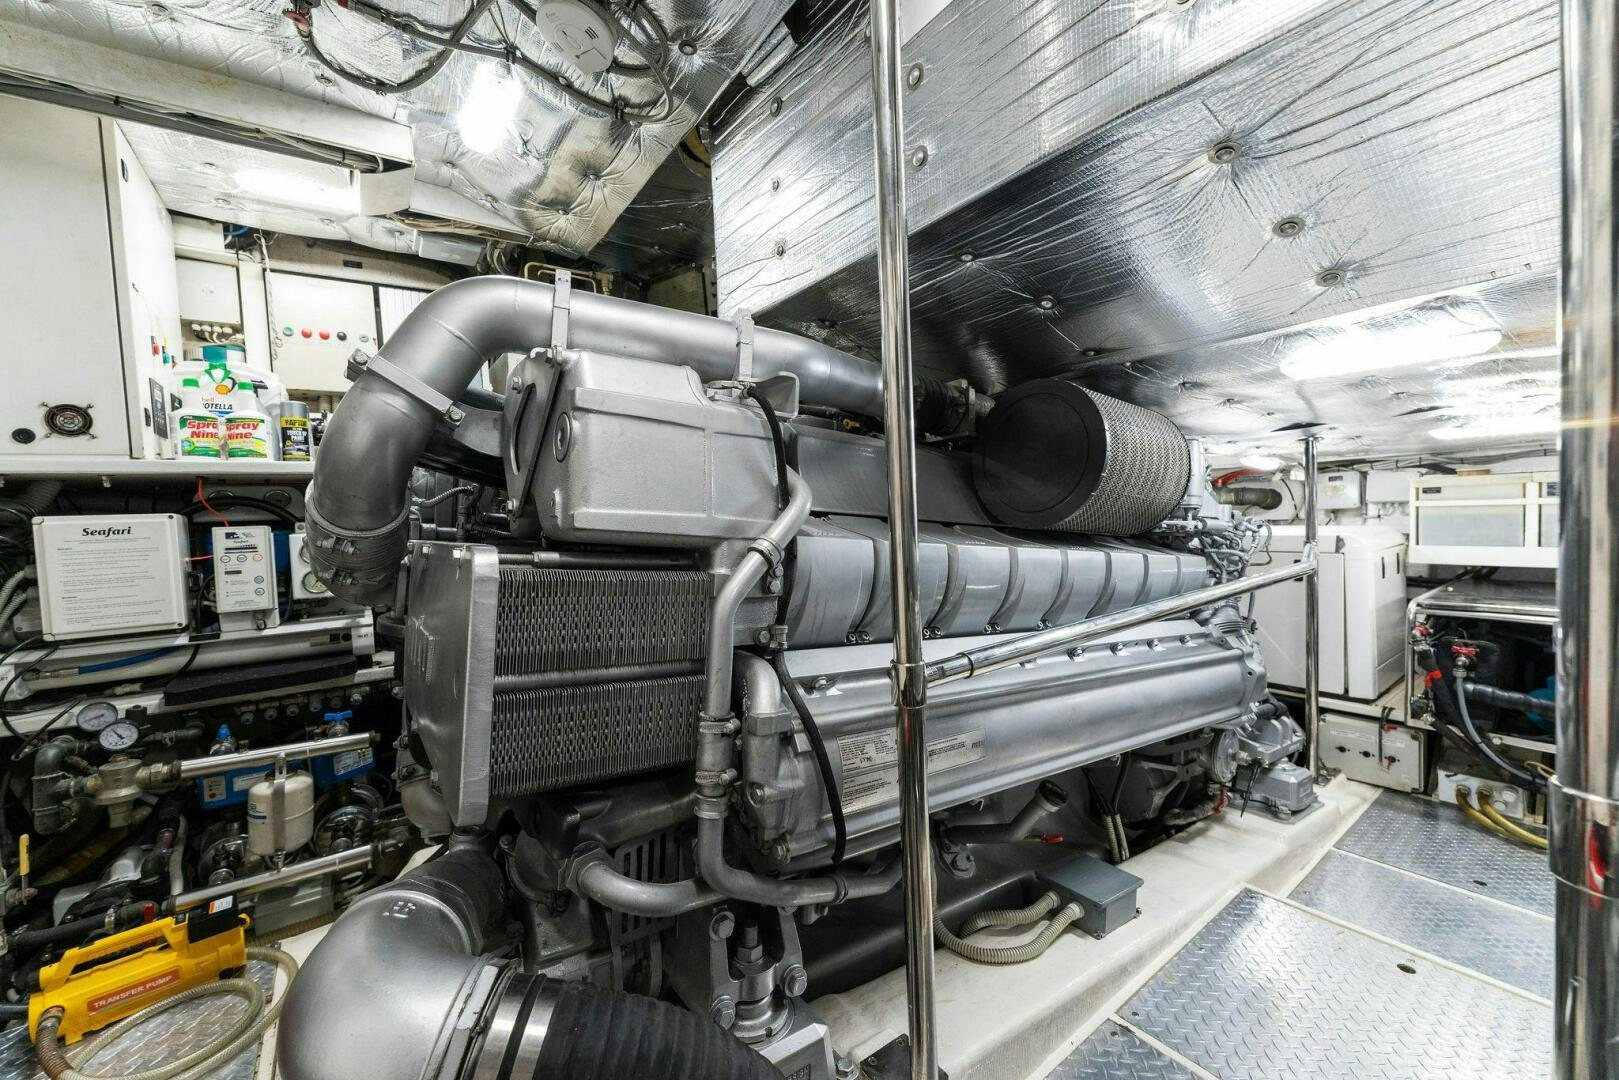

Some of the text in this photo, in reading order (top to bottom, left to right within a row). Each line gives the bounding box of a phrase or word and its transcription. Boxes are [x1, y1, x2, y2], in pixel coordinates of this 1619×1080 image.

[203, 402, 233, 410] OTELLA
[82, 526, 132, 538] Seafari
[93, 975, 173, 1009] TRANSFER PUMP
